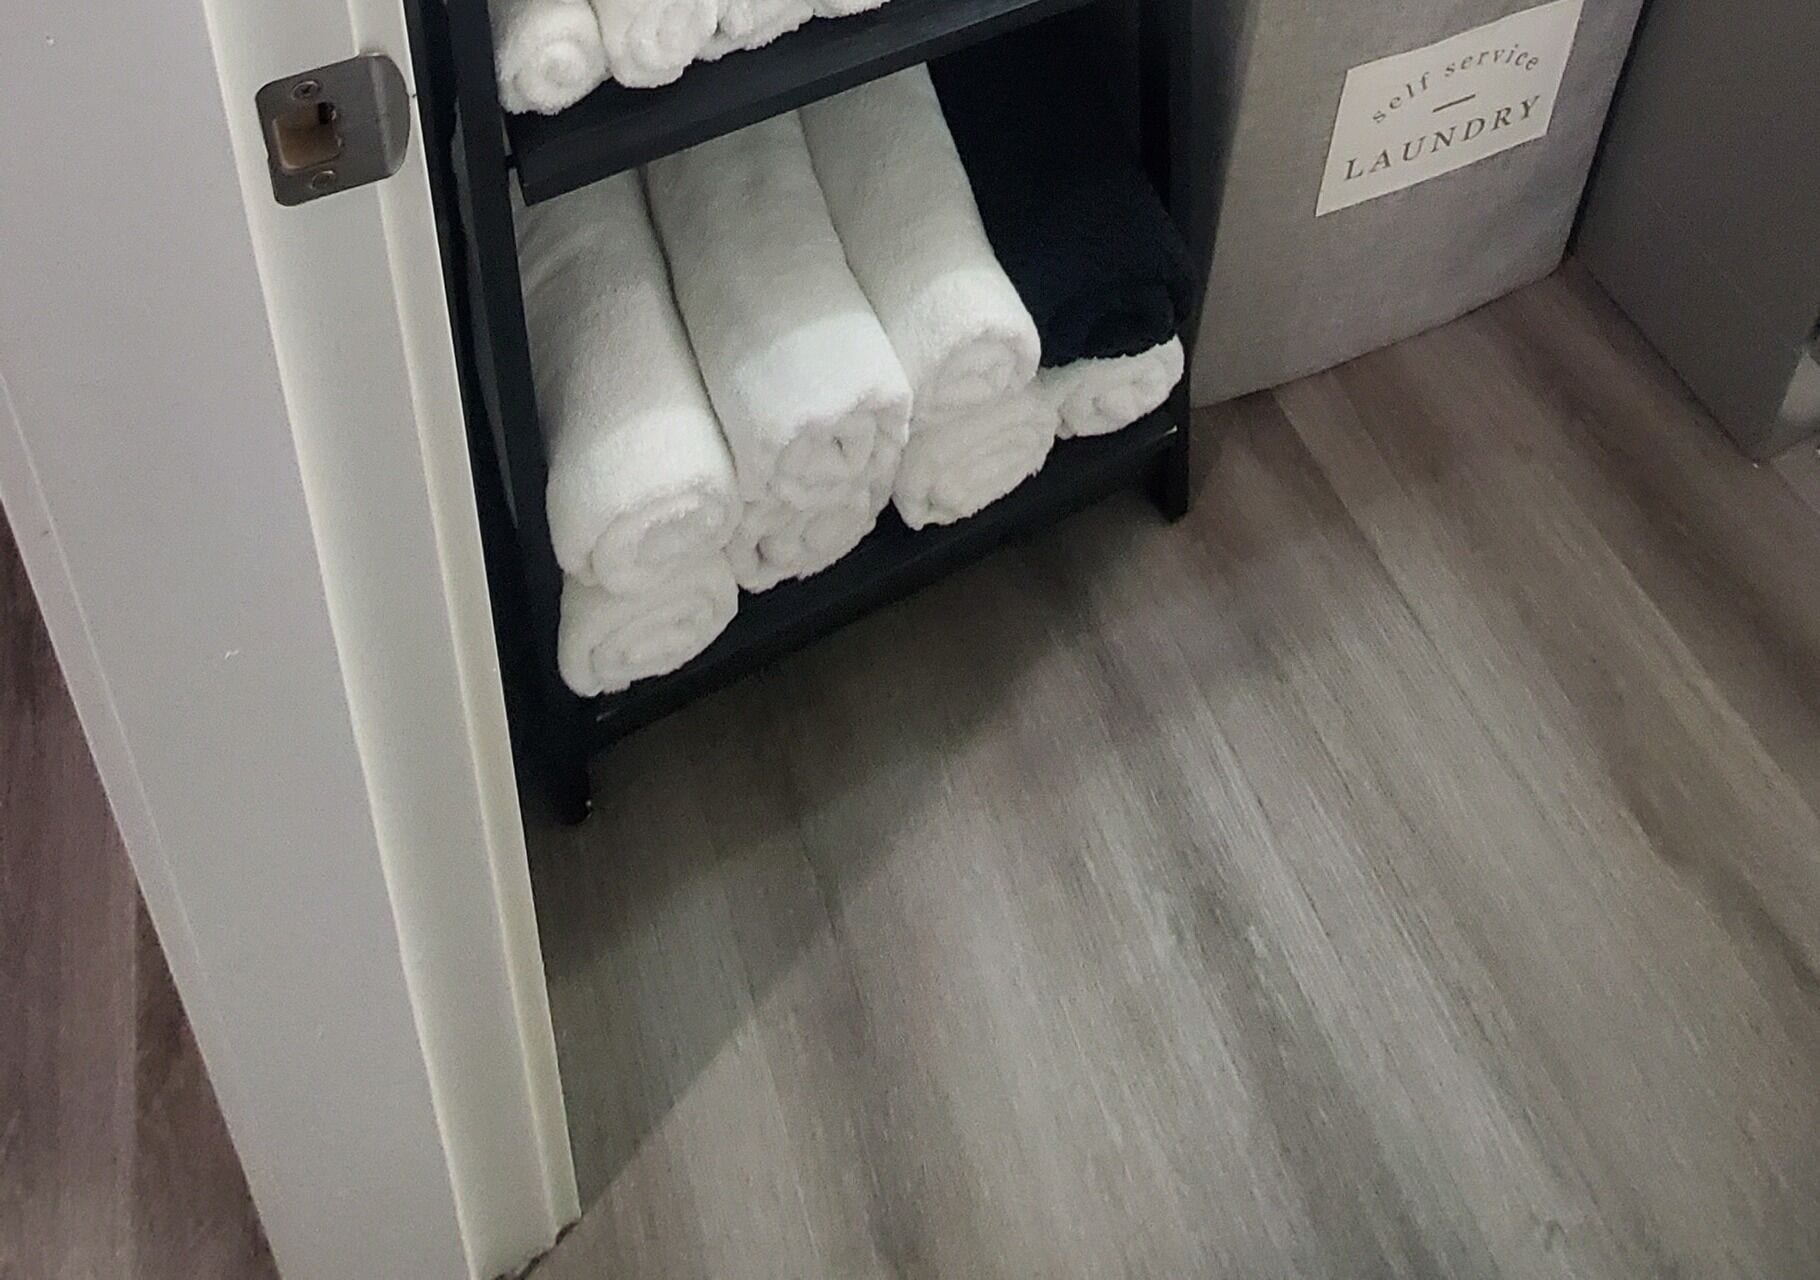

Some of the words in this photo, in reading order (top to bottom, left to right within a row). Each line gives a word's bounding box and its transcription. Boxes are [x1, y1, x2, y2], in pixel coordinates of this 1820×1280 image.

[1372, 71, 1430, 124] self
[1443, 43, 1540, 78] service
[1344, 95, 1541, 182] LAUNDRY
